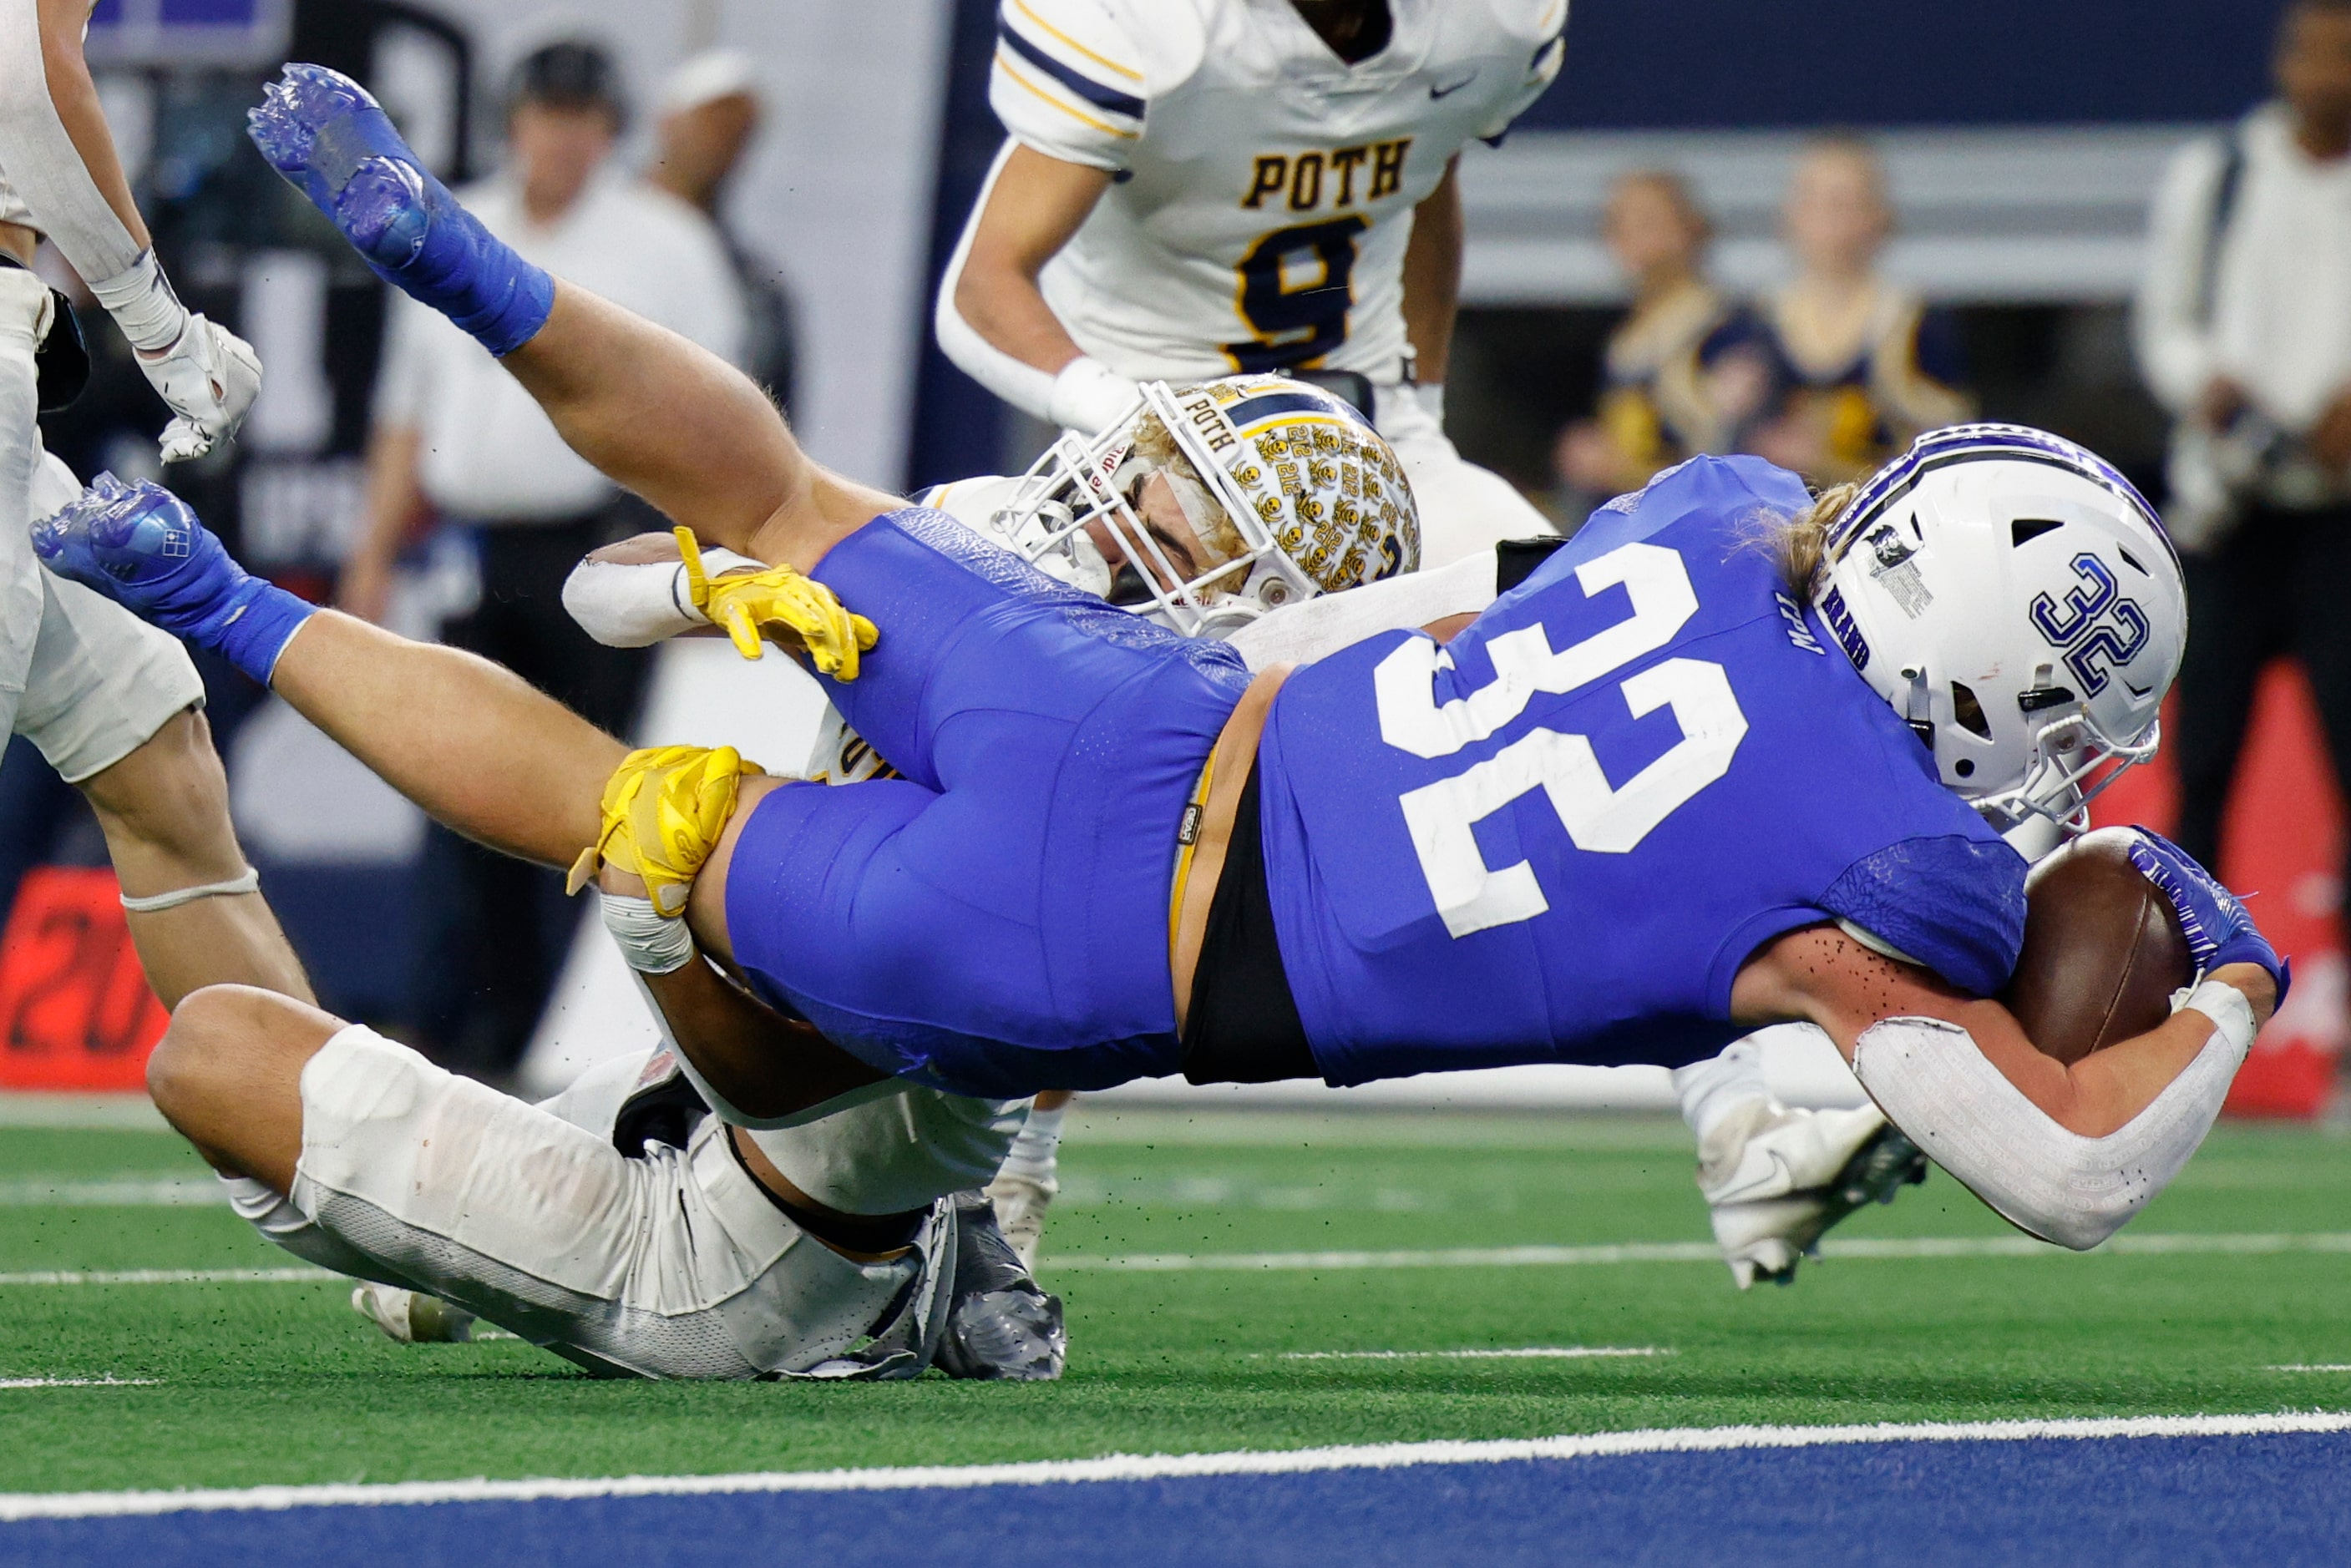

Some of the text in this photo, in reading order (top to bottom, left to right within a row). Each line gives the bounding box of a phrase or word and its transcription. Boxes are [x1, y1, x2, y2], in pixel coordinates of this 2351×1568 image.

[1240, 136, 1415, 212] POTH
[1220, 213, 1375, 373] 9
[1184, 398, 1236, 453] POTH
[1287, 425, 1314, 458] 212
[1276, 462, 1304, 497] 212
[1341, 462, 1360, 498] 212
[1313, 519, 1345, 555] 212
[1775, 591, 1827, 655] TPW
[1821, 584, 1870, 671] BRAND
[2029, 553, 2151, 700] 32
[1374, 542, 1750, 940] 32
